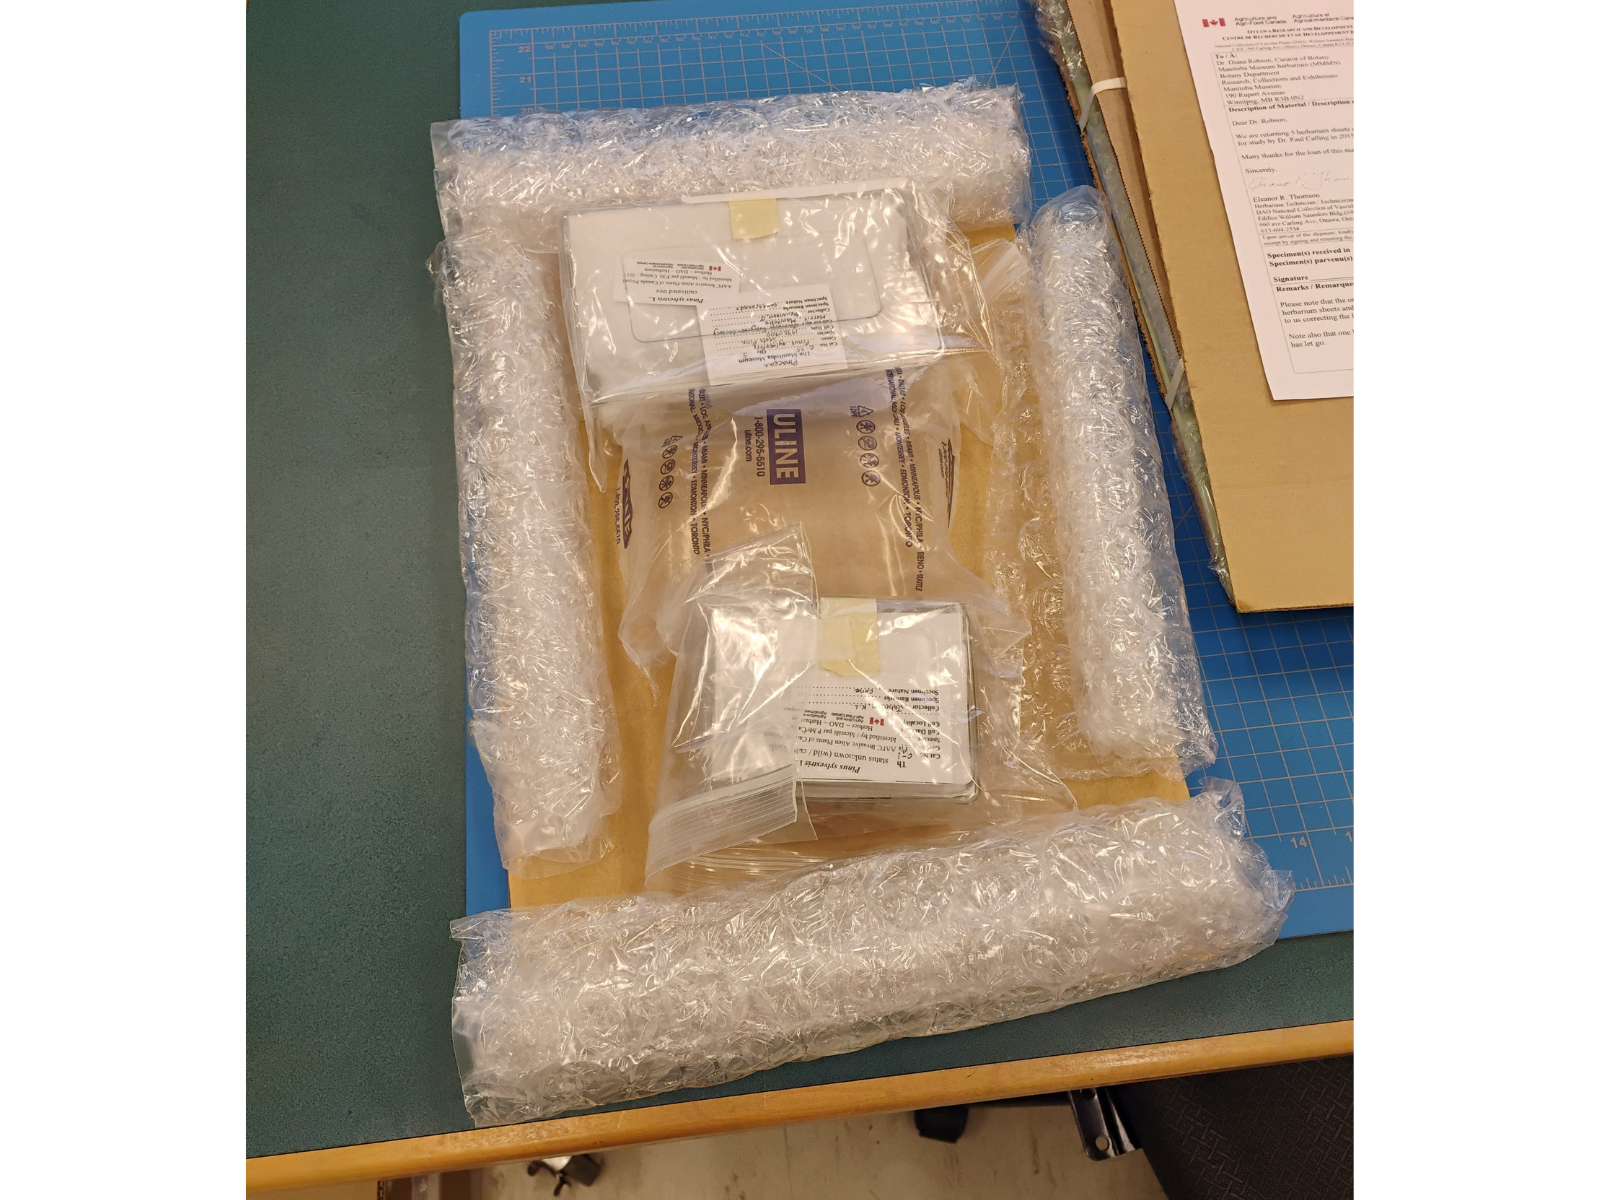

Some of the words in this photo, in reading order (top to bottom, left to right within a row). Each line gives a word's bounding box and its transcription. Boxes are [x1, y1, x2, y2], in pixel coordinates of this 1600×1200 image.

[1267, 250, 1310, 259] Specimen(s)
[1269, 258, 1312, 267] Specimen(s)
[1315, 256, 1353, 264] parvenu(s)
[1276, 284, 1309, 292] Remarks
[1303, 314, 1338, 322] correcting
[738, 356, 766, 364] Museum
[767, 352, 798, 360] Manitoba
[754, 417, 765, 477] 1-800-295-5510
[773, 413, 799, 479] ULINE
[895, 432, 906, 463] MONTERREY
[906, 441, 914, 458] MIAMI
[899, 469, 911, 504] EDMONTON
[908, 463, 921, 501] MINNEAPOLIS
[904, 513, 913, 547] TORONTO
[691, 523, 700, 555] TORONTO
[701, 518, 711, 553] NYC/PHILA
[903, 719, 926, 727] Locality
[860, 732, 868, 740] by
[869, 734, 896, 743] Identified
[835, 739, 850, 747] Alien
[851, 742, 875, 750] Invasive
[813, 749, 832, 758] (wild
[804, 759, 838, 771] sylvestris
[839, 765, 861, 774] Pinus
[1290, 836, 1308, 848] 14
